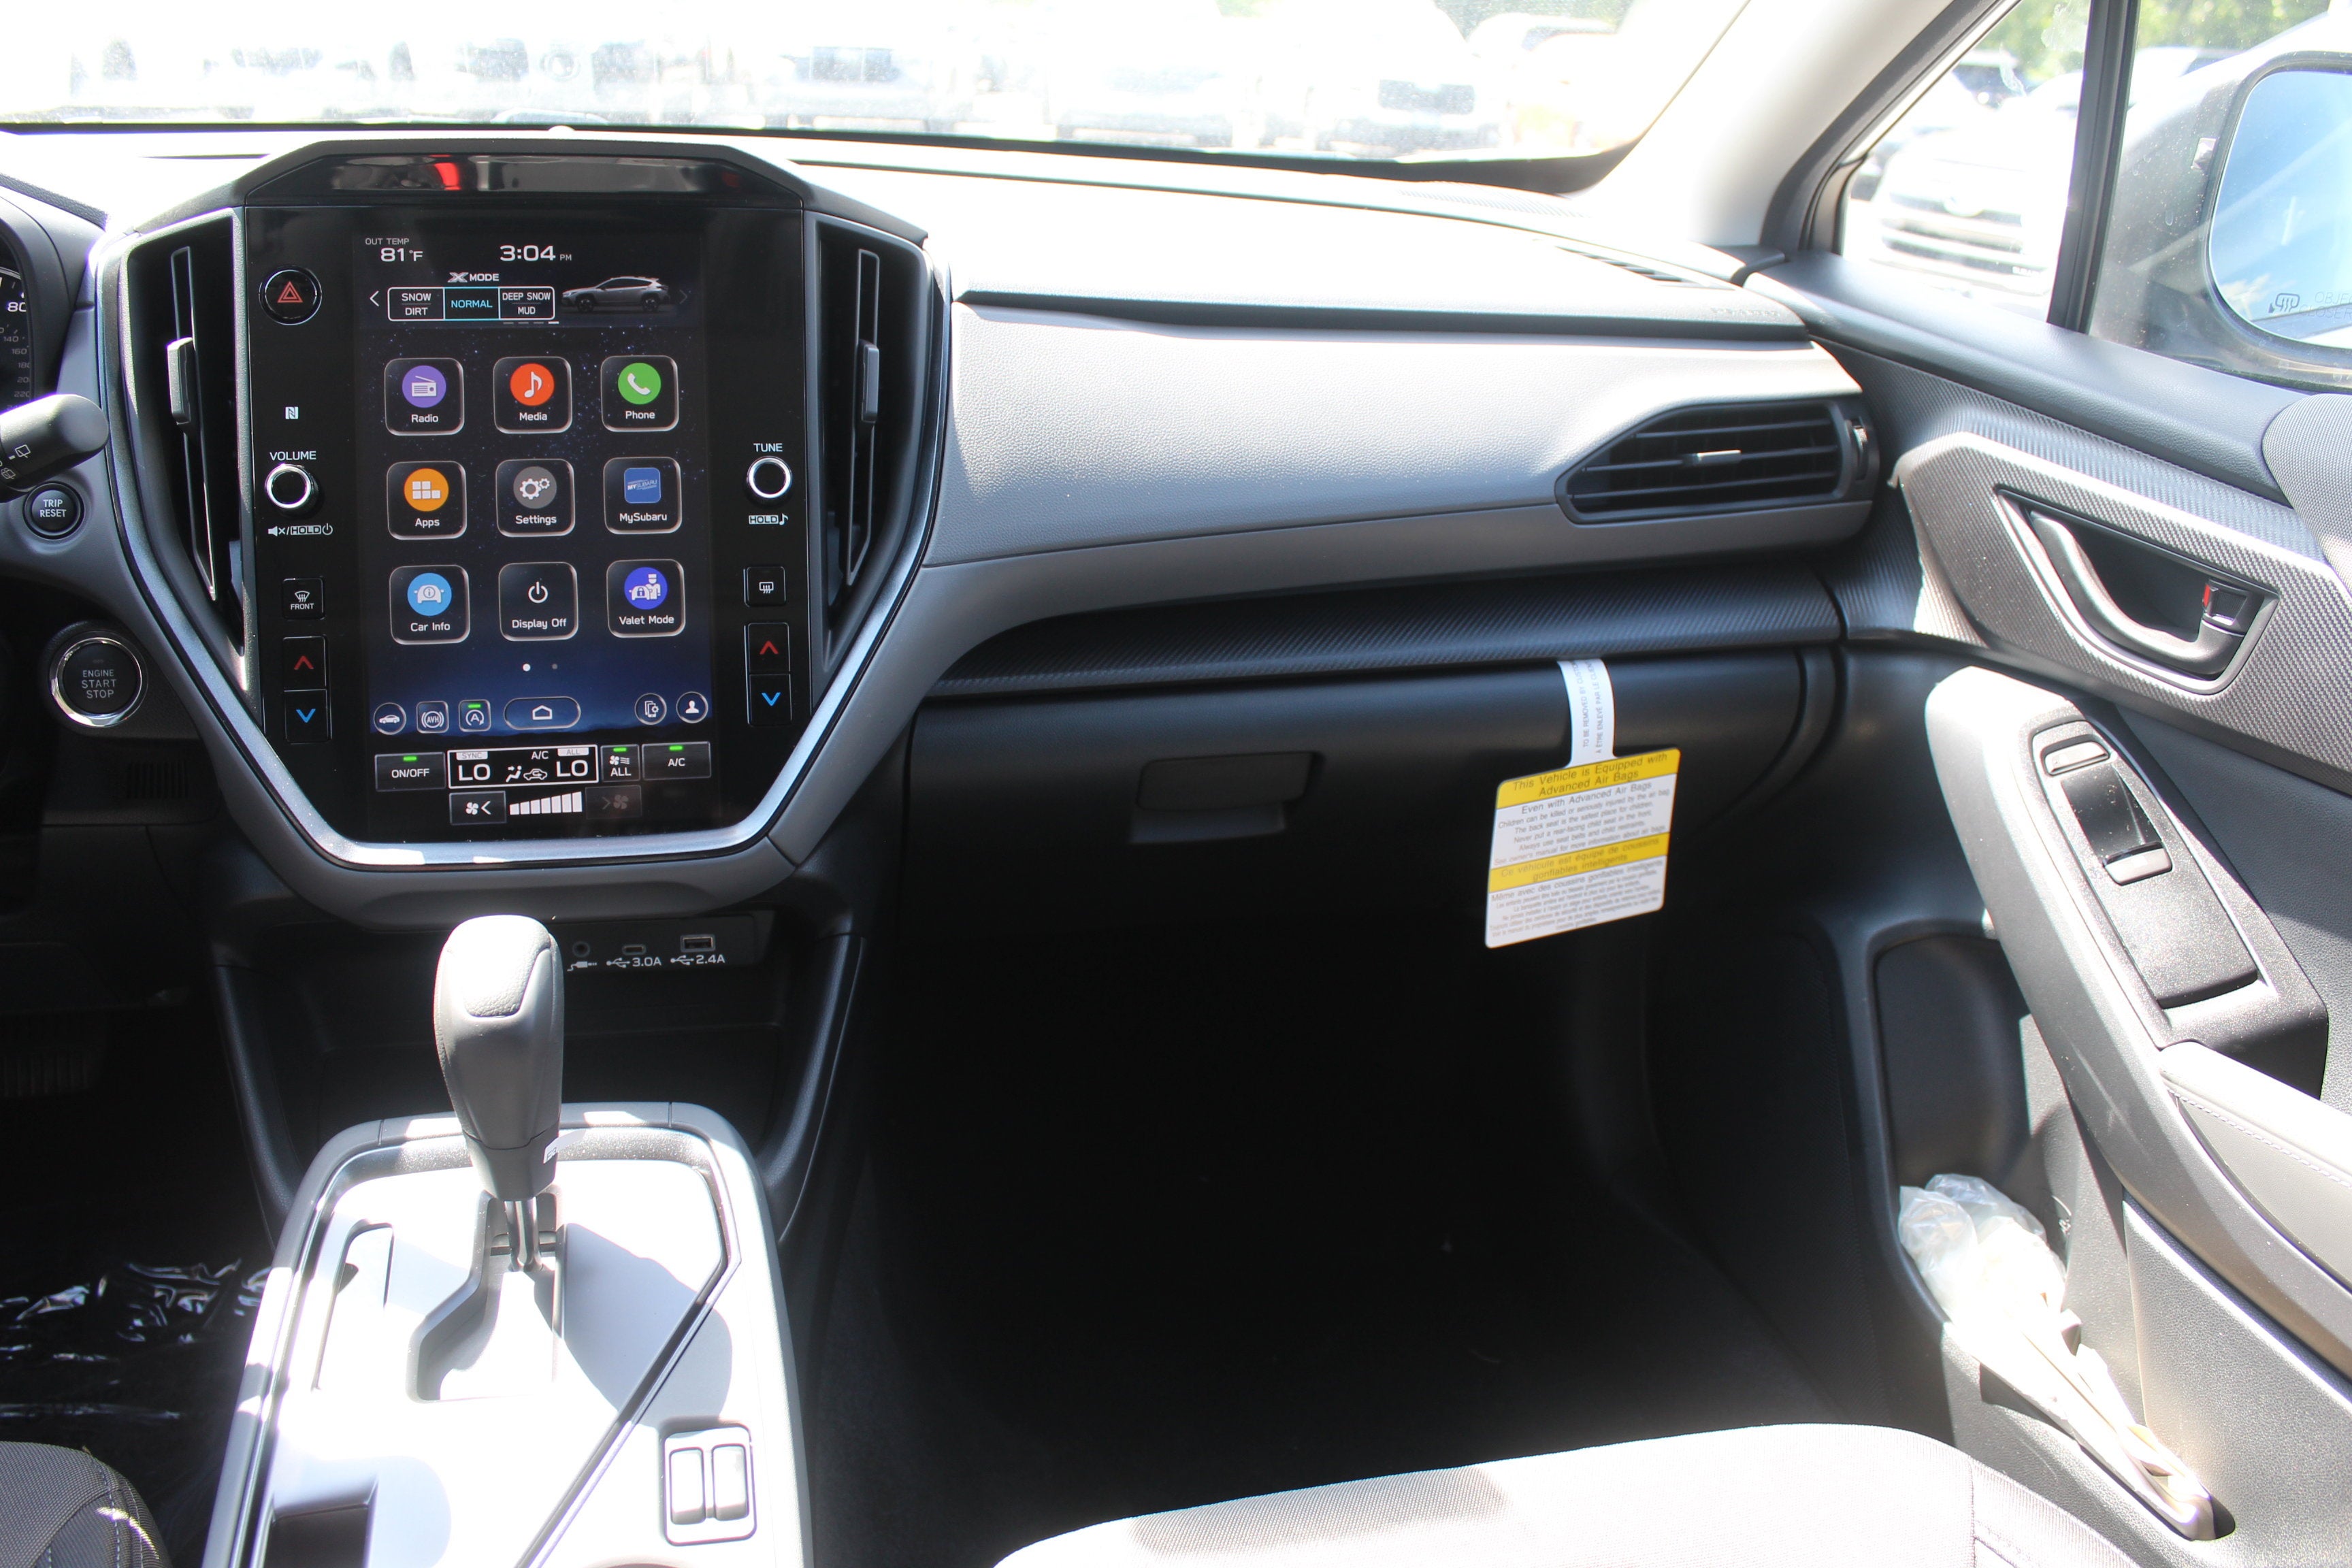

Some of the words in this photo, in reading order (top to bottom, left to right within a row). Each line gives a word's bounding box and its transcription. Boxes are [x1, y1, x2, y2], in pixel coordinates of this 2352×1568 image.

[365, 238, 383, 246] OUT
[386, 237, 410, 245] TEMP
[500, 245, 556, 262] 3:04
[559, 253, 572, 261] PM
[401, 293, 431, 301] SNOW
[502, 293, 524, 301] DEEP
[526, 292, 551, 300] SNOW
[451, 299, 493, 308] NORMAL
[405, 308, 428, 316] DIRT
[518, 306, 536, 315] MUD
[411, 414, 439, 423] Radio
[519, 412, 548, 421] Media
[625, 410, 655, 420] Phone
[753, 443, 783, 453] TUNE
[270, 451, 316, 461] VOLUME
[44, 500, 63, 508] TRIP
[39, 509, 67, 518] RESET
[619, 512, 667, 523] MySubaru
[415, 517, 440, 528] Apps
[515, 514, 557, 526] Settings
[749, 515, 778, 524] HOLD
[512, 619, 548, 630] Display
[551, 618, 567, 627] Off
[619, 615, 645, 625] Valet
[648, 615, 674, 625] Mode
[410, 621, 429, 632] Car
[432, 621, 451, 631] Info
[82, 669, 114, 678] ENGINE
[81, 679, 116, 689] START
[86, 689, 114, 699] STOP
[531, 750, 549, 760] A/C
[668, 757, 686, 767] A/C
[391, 768, 430, 779] ON/OFF
[459, 764, 491, 781] LO
[556, 760, 589, 777] LO
[610, 767, 632, 777] ALL
[1512, 777, 1535, 791] This
[1539, 769, 1577, 786] Vehicle
[1581, 767, 1590, 777] is
[1594, 756, 1643, 779] Equipped
[1648, 751, 1667, 764] with
[1539, 778, 1590, 797] Advanced
[1595, 774, 1609, 786] Air
[1612, 768, 1639, 784] Bags
[1521, 802, 1544, 814] Even
[1547, 798, 1565, 808] with
[1569, 788, 1612, 804] Advanced
[1614, 785, 1627, 795] Air
[1630, 780, 1652, 794] Bags
[632, 957, 662, 967] 3.0A
[696, 954, 725, 964] 2.4A
